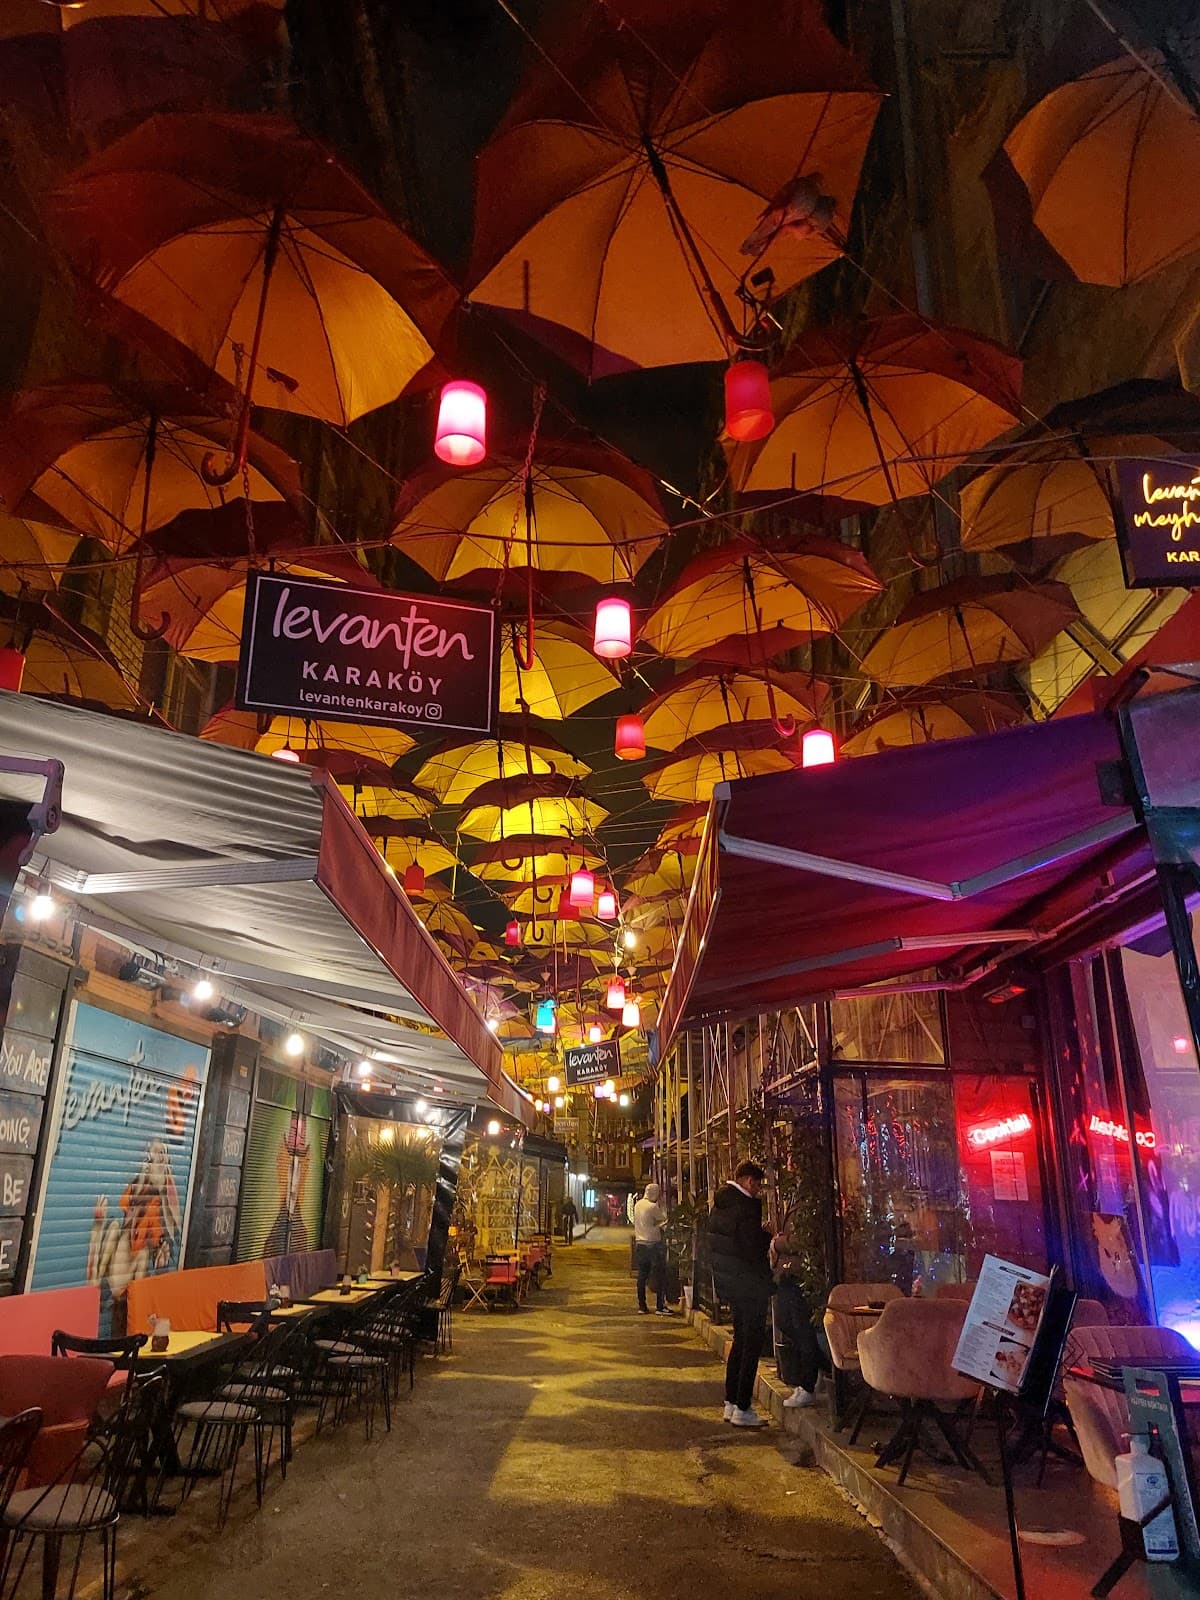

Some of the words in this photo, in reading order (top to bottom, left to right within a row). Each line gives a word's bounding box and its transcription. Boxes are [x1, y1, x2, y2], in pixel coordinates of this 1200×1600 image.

[1143, 473, 1200, 504] levan
[1134, 500, 1200, 541] meyh
[272, 587, 474, 670] levanten
[302, 660, 442, 696] KARAKÖY
[299, 689, 423, 718] levantenkarakoy
[23, 1048, 49, 1087] ARE
[569, 1046, 614, 1067] levanten
[3, 1172, 25, 1207] BE
